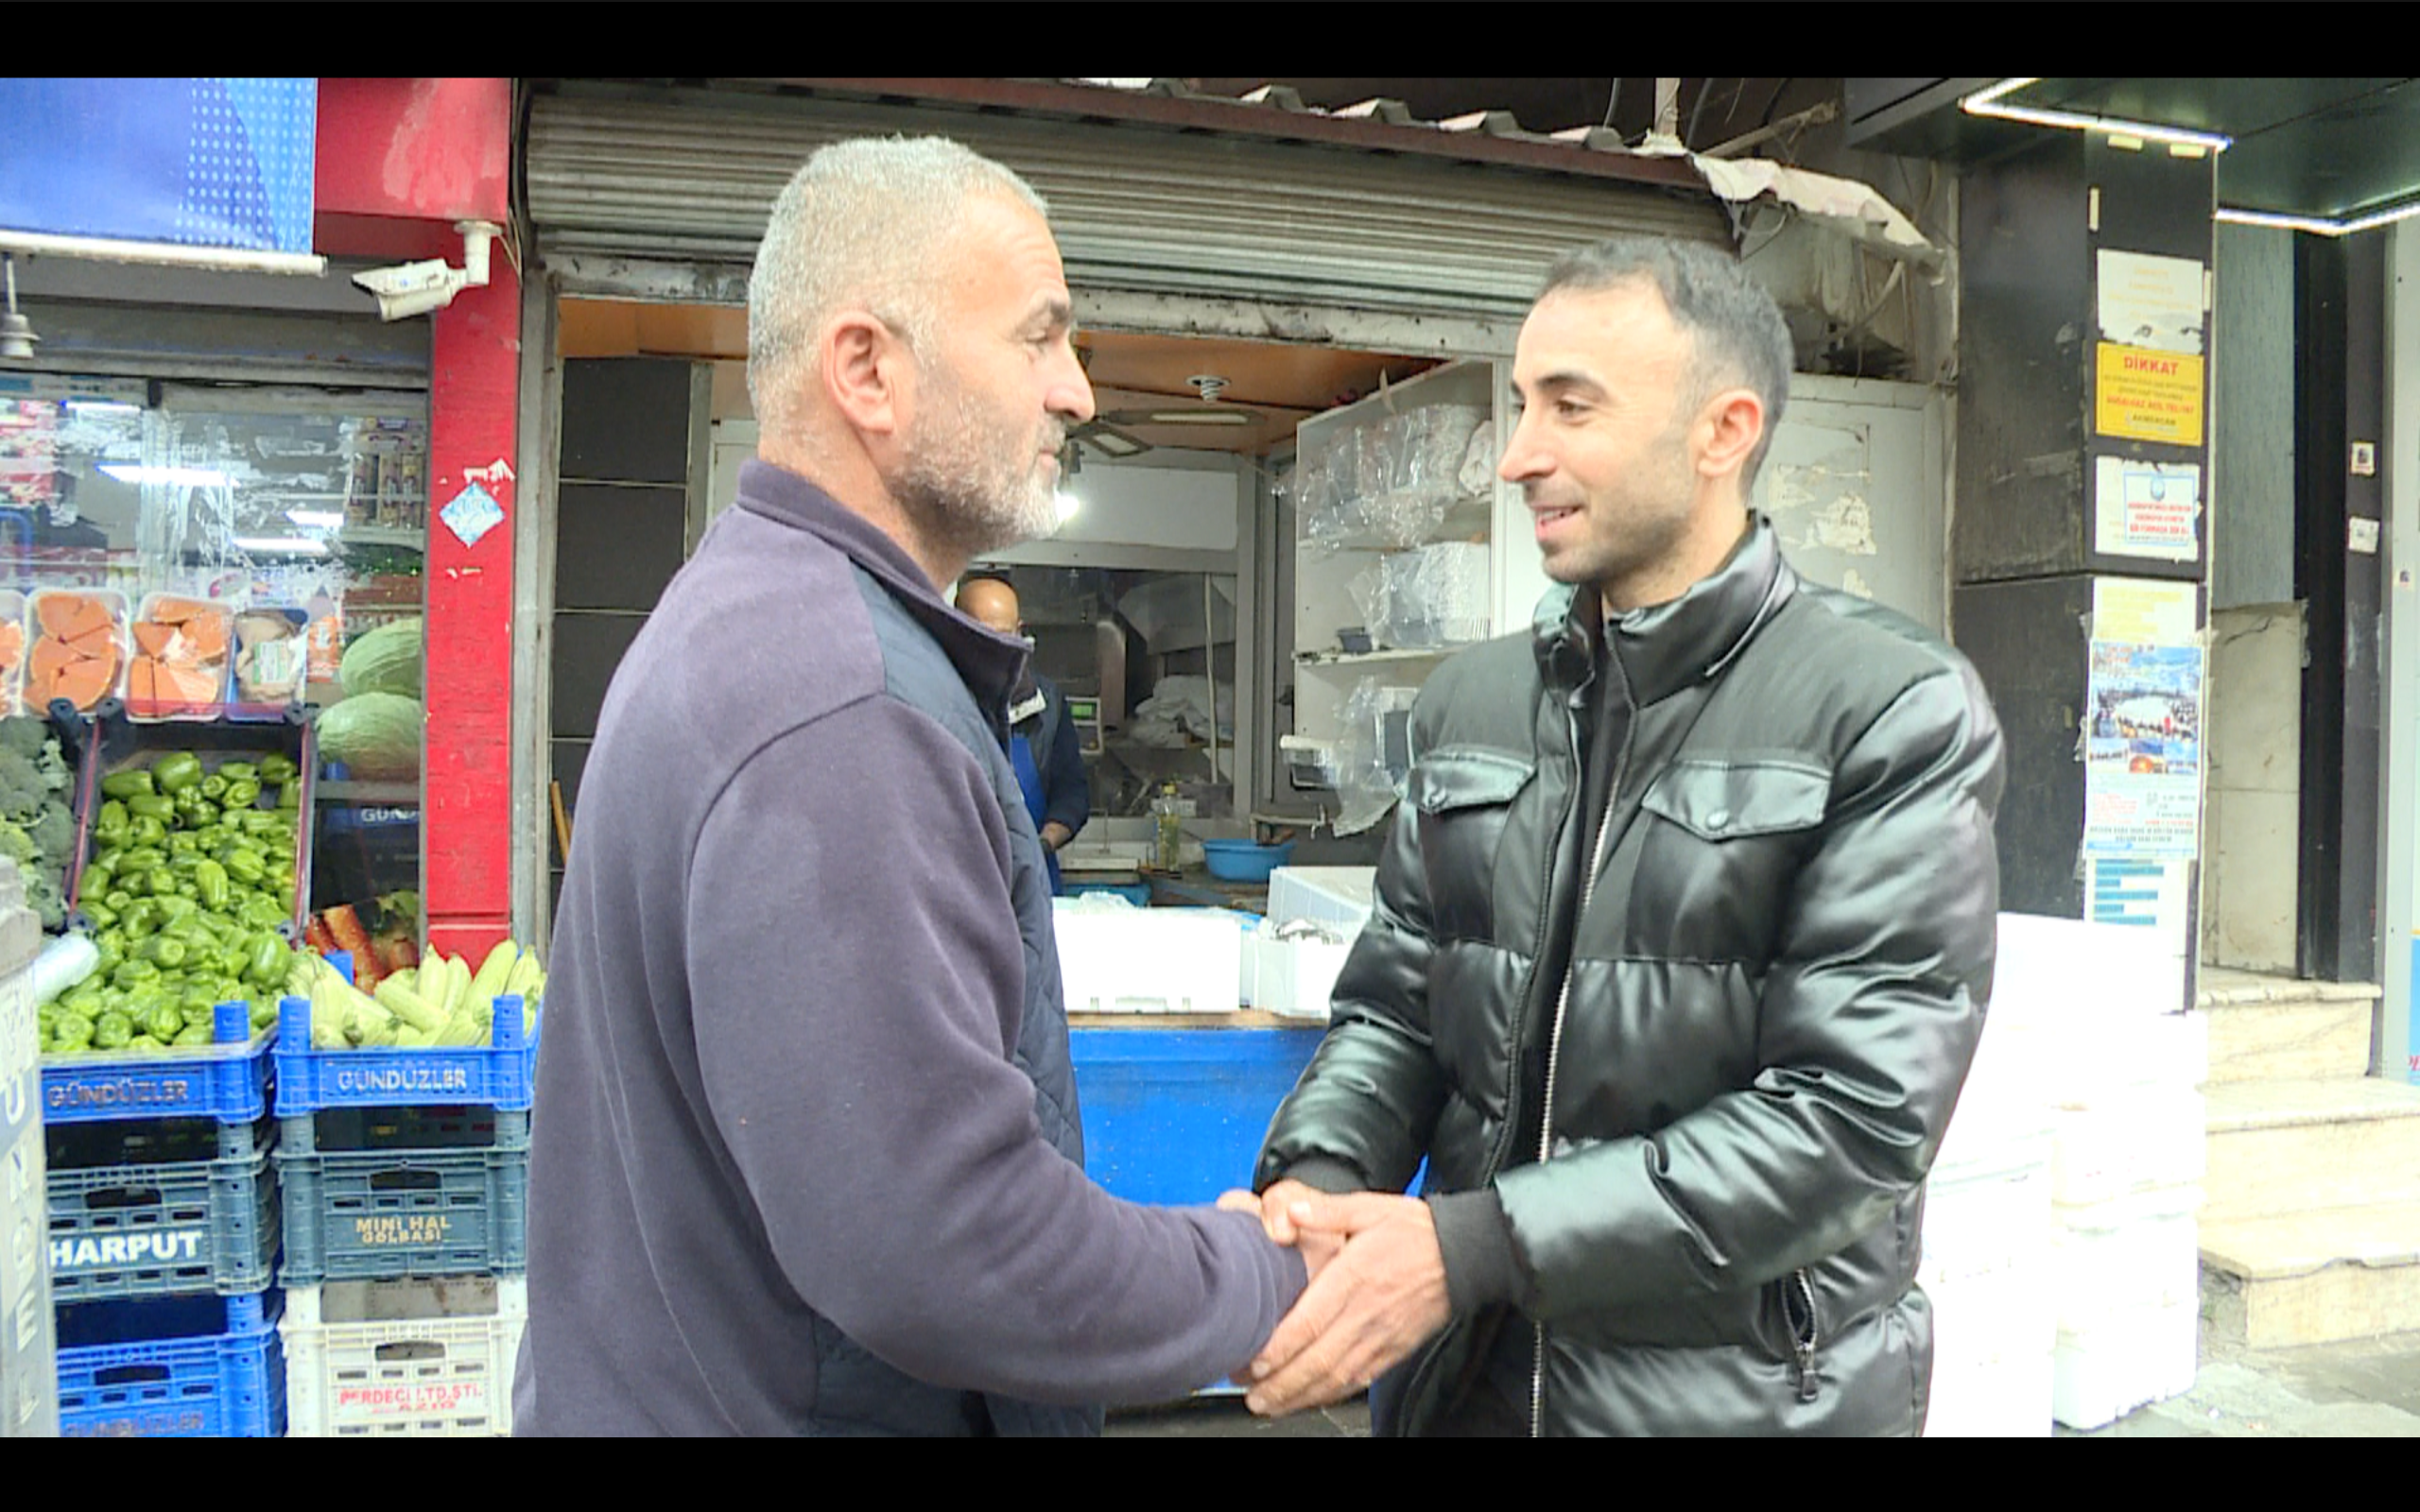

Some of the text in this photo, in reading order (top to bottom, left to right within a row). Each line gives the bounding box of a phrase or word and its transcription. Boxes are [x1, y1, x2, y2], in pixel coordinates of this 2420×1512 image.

[2123, 353, 2179, 376] DİKKAT
[408, 1214, 452, 1231] HAL
[49, 1230, 203, 1267] HARPUT
